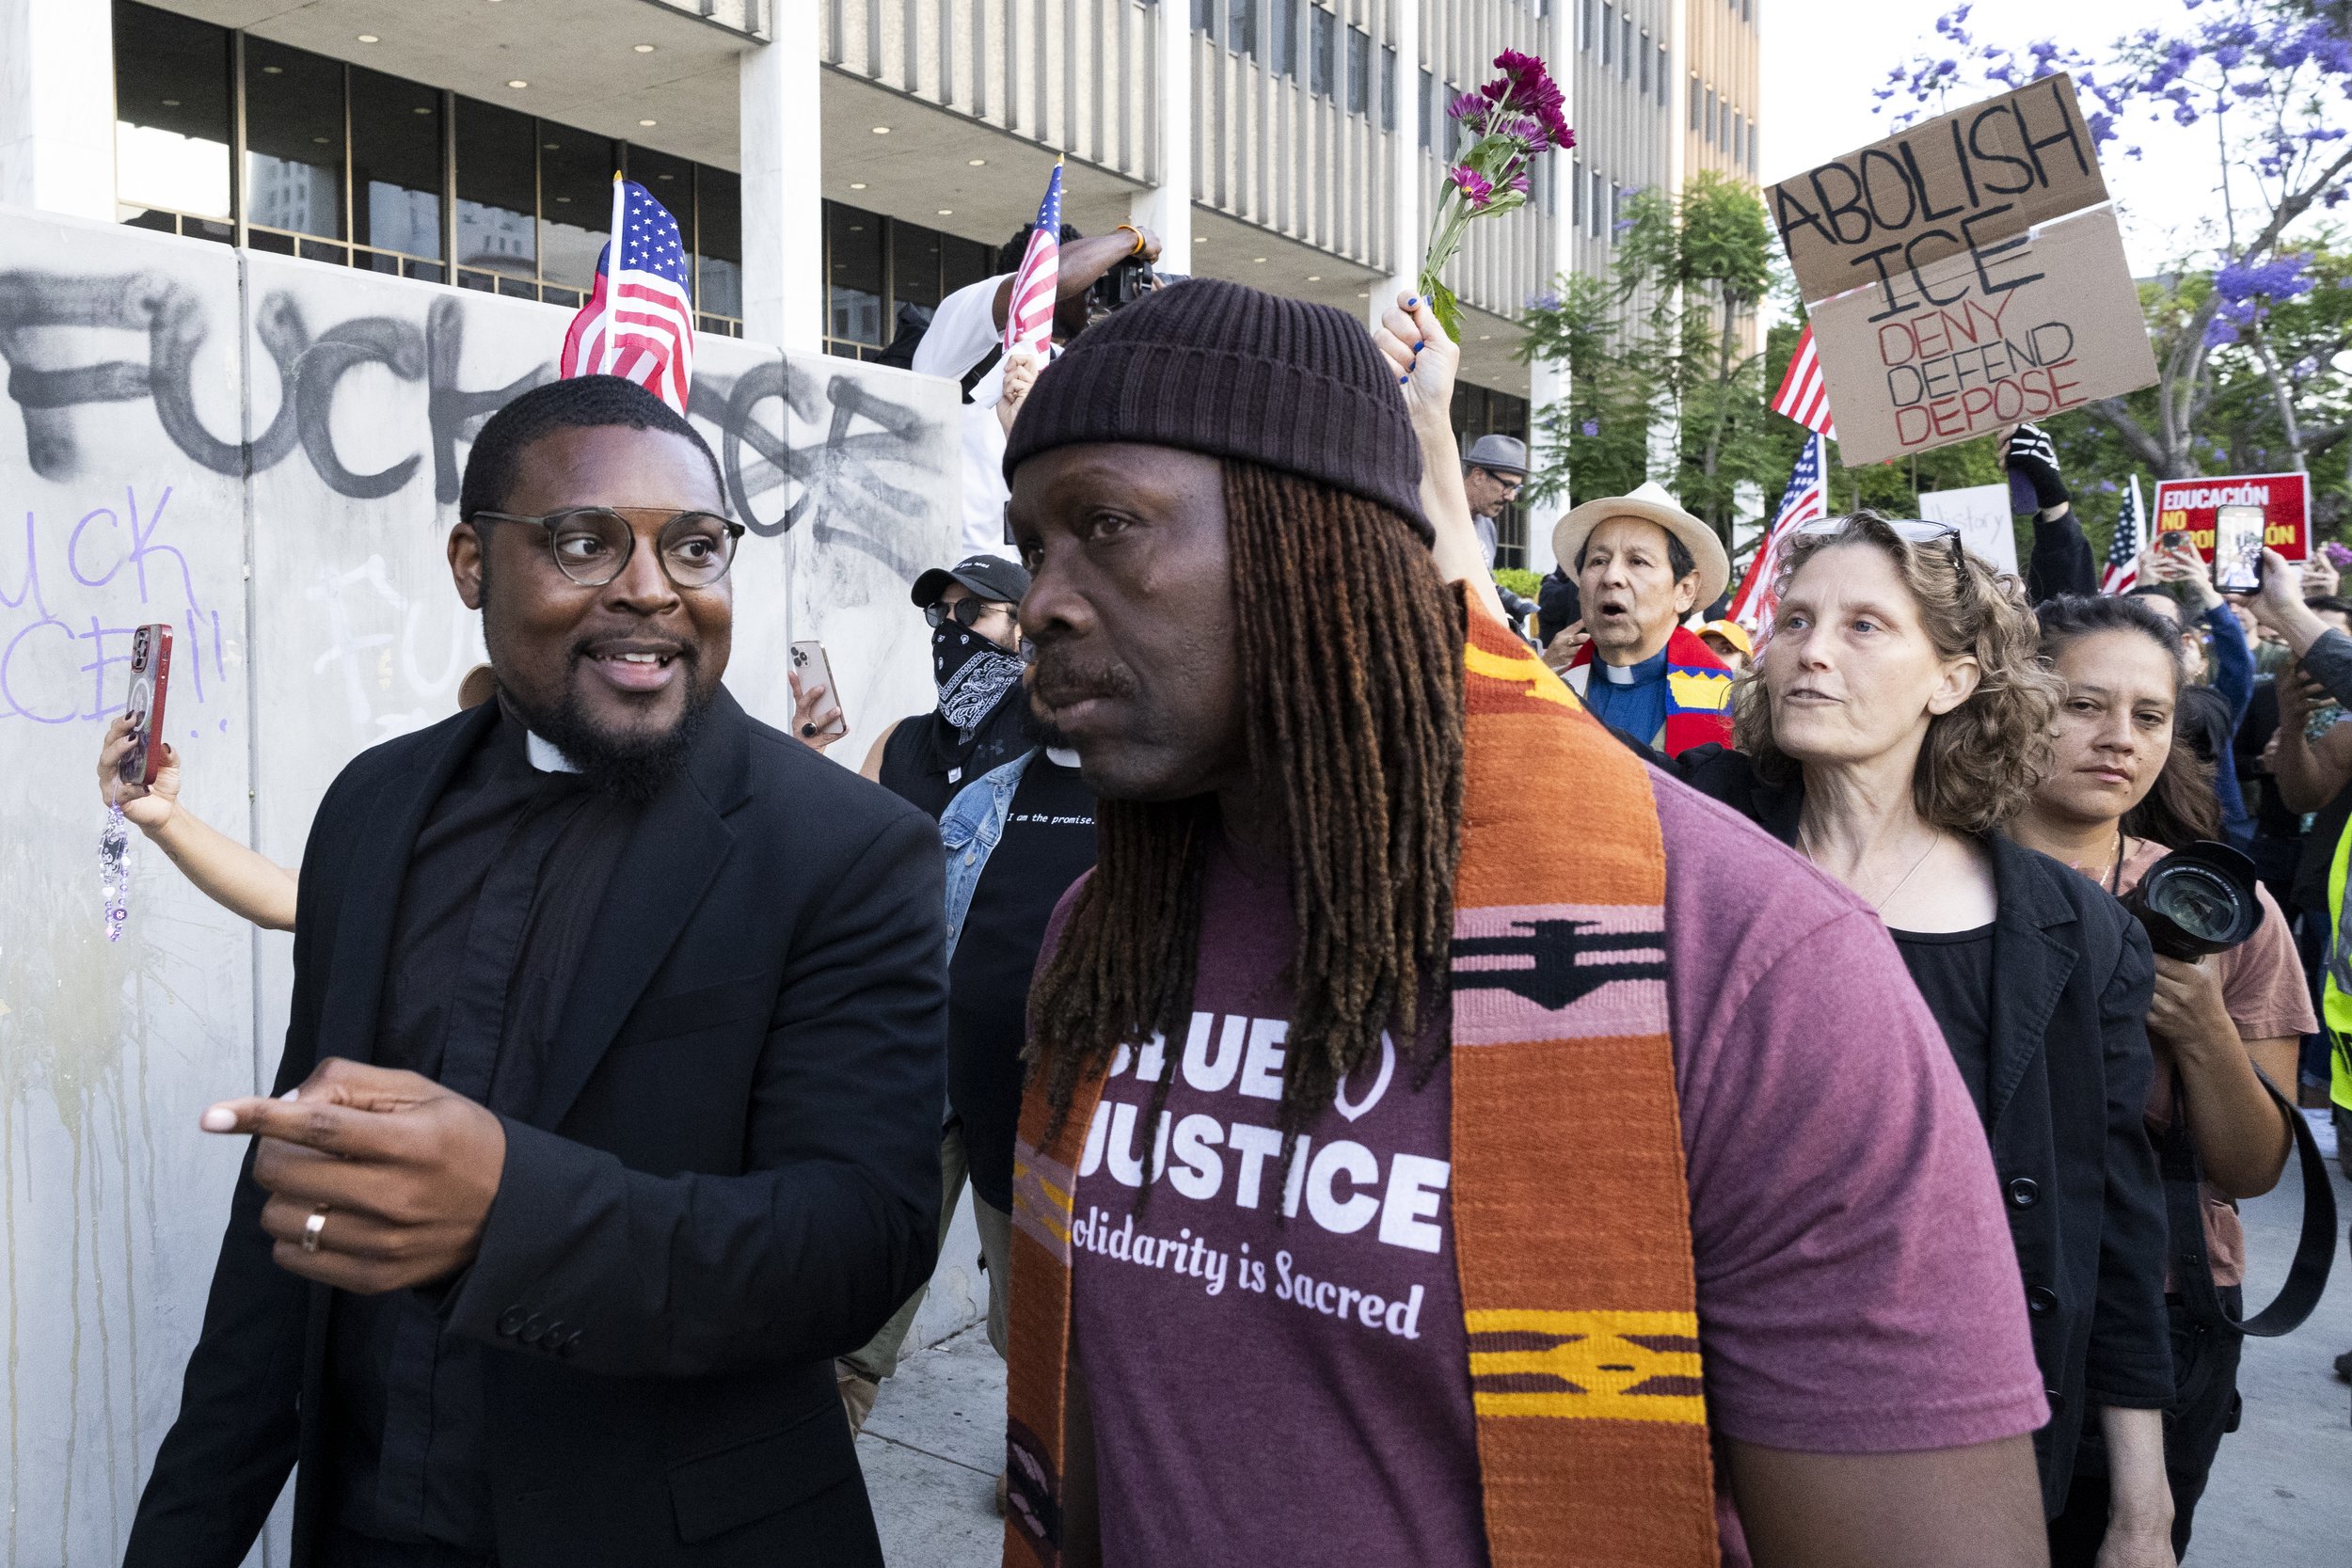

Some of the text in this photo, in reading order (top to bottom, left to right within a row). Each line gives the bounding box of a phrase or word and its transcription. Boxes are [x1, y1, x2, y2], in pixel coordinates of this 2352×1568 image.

[1775, 82, 2090, 261] ABOLISH
[1851, 203, 2045, 323] ICE
[1879, 288, 2016, 367] DENY
[1888, 323, 2074, 407] DEFEND
[0, 267, 554, 504] FUCK
[1895, 359, 2088, 446] DEPOSE
[2161, 510, 2187, 531] NO
[2163, 482, 2269, 511] EDUCACIÓN
[1006, 813, 1014, 822] I
[1031, 813, 1049, 823] the
[1051, 815, 1095, 825] promise.
[1078, 1101, 1451, 1254] JUSTICE
[1073, 1205, 1425, 1340] olidarity is Sacred
